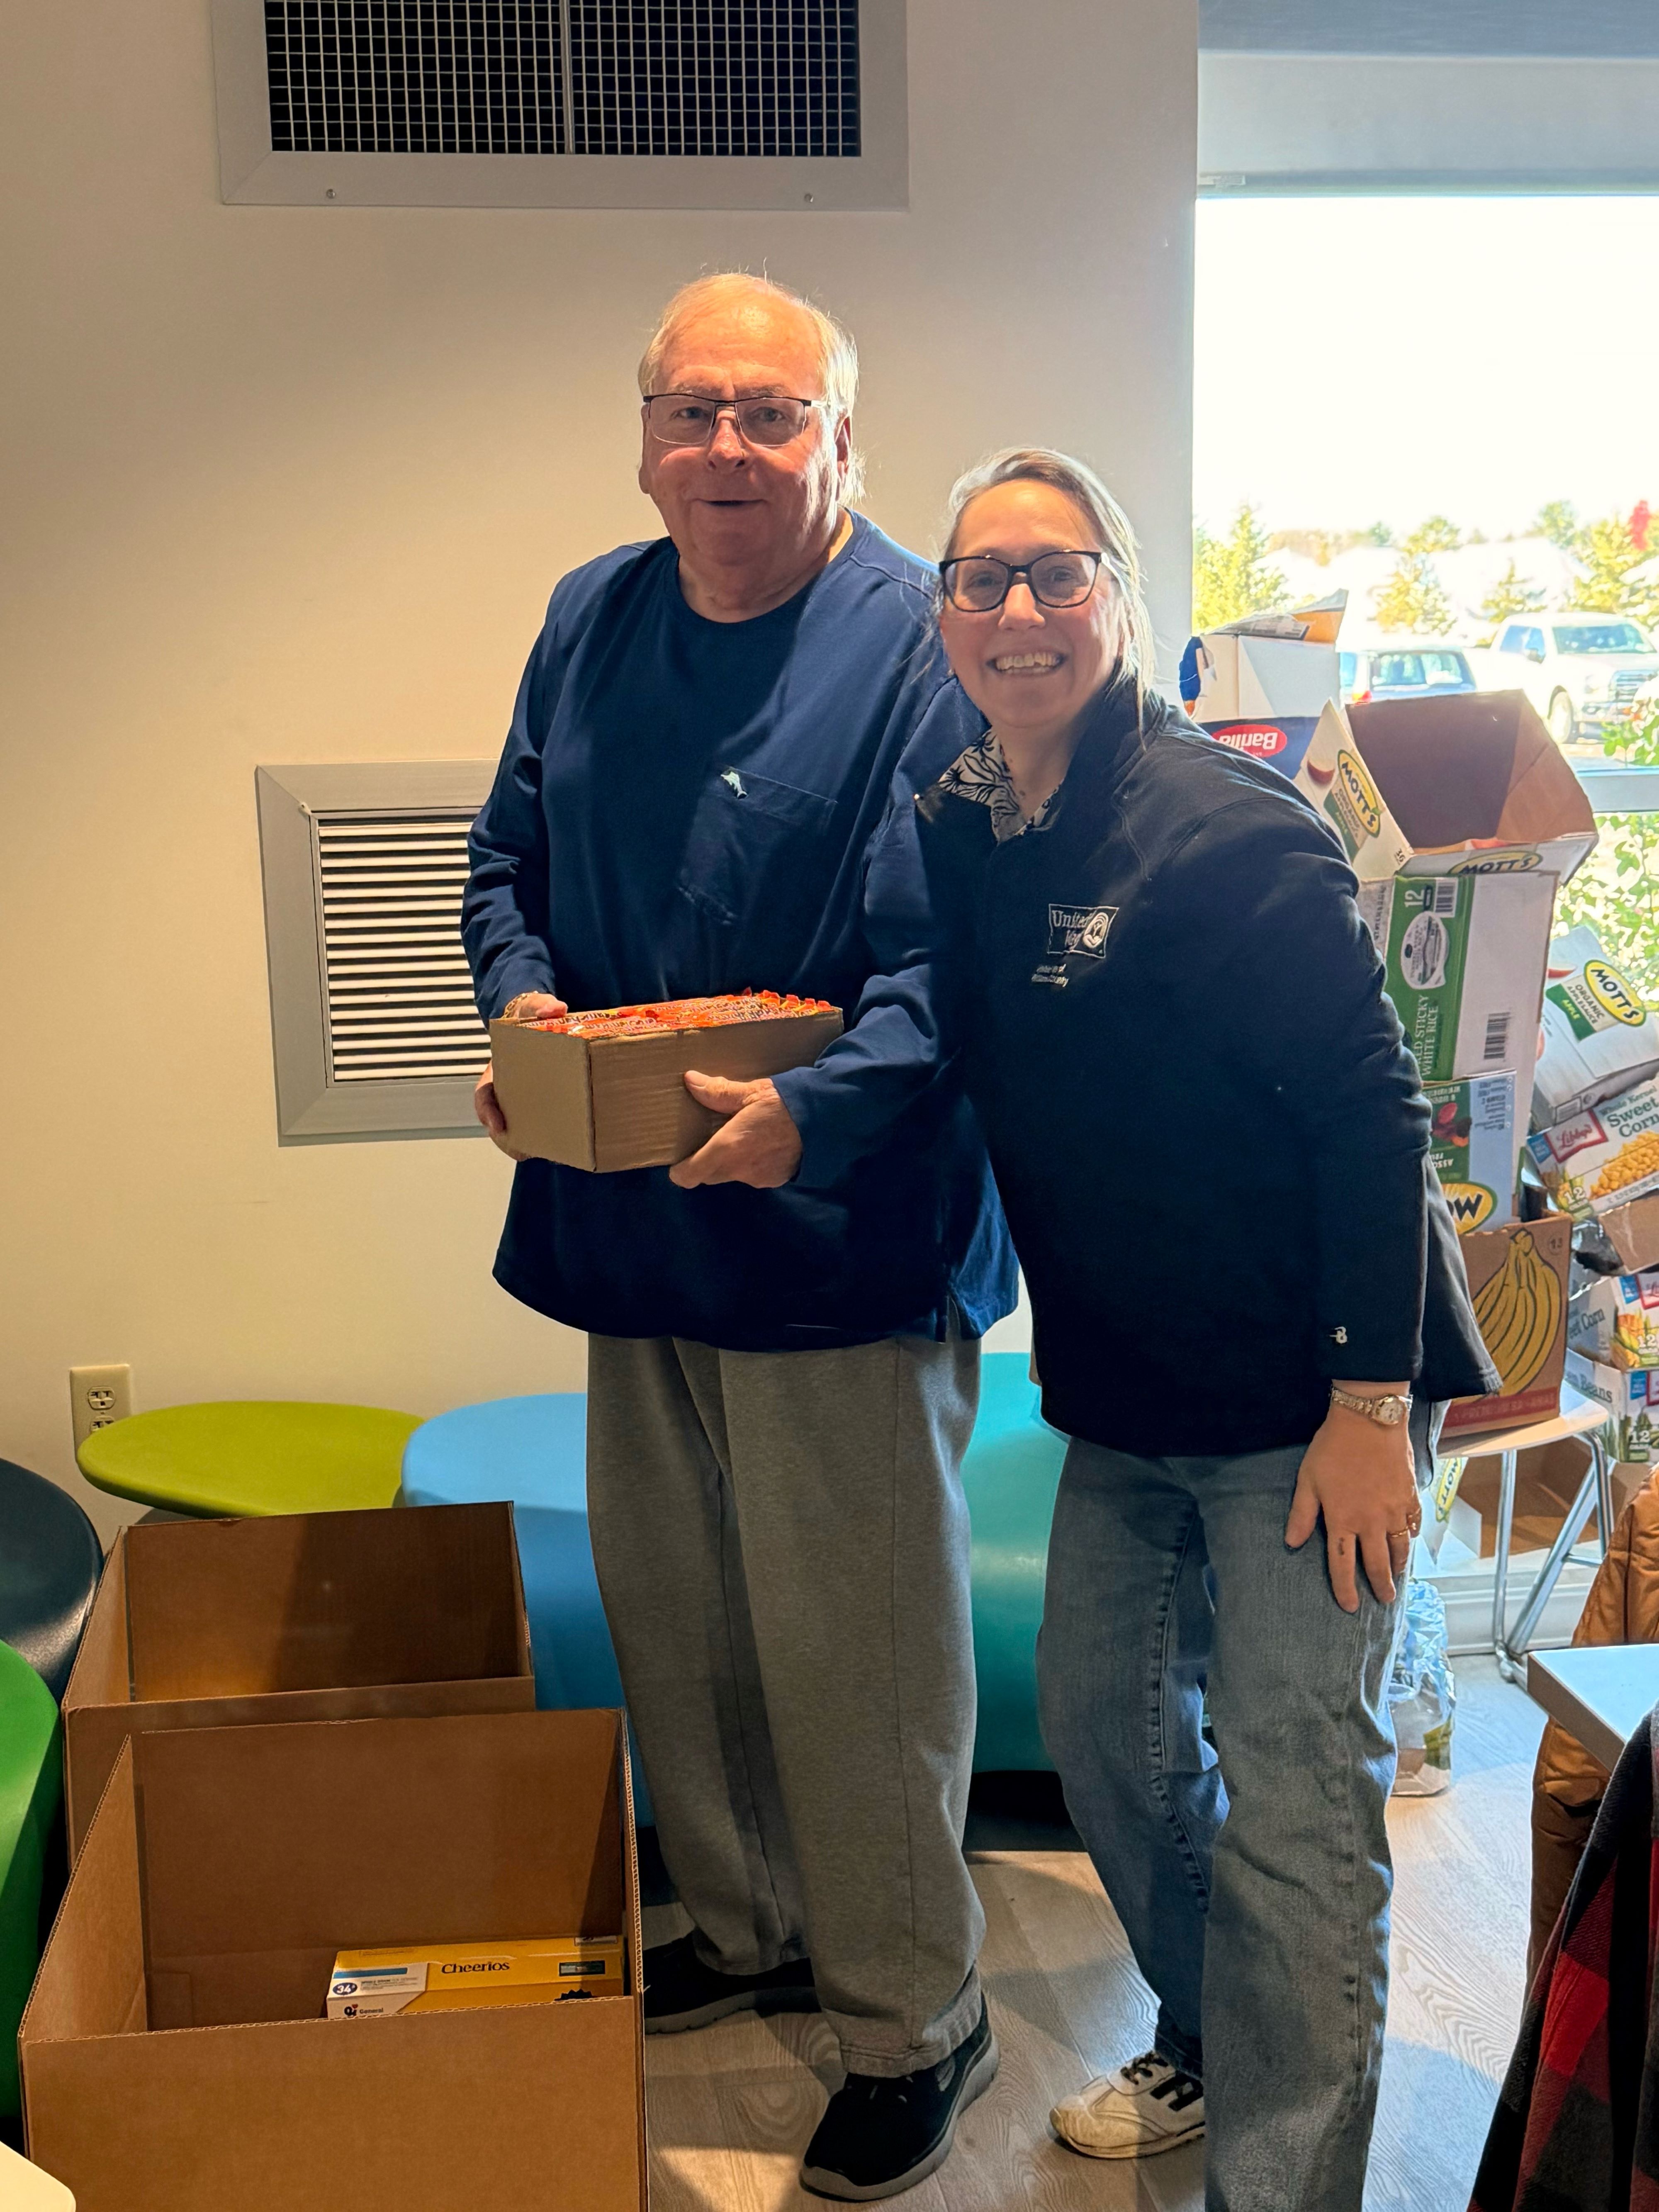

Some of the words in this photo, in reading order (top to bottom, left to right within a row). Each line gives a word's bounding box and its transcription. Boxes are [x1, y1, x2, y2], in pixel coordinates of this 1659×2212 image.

[1218, 732, 1279, 750] Barilla
[1404, 889, 1425, 908] 12
[1562, 999, 1581, 1020] APPLE
[1567, 986, 1598, 1024] APPLESAUCE
[1575, 984, 1605, 1019] ORGANIC
[1415, 995, 1429, 1038] STICKY
[1425, 1005, 1439, 1033] RICE
[1421, 1037, 1435, 1076] WHITE
[1627, 1085, 1658, 1103] Kernel
[1606, 1096, 1659, 1128] Sweet
[1619, 1113, 1659, 1137] Corn
[1564, 1187, 1586, 1205] 12
[1581, 1309, 1605, 1329] Corn
[1637, 1334, 1656, 1348] 12
[1580, 1373, 1612, 1404] Beans
[1630, 1430, 1651, 1443] 12
[441, 1961, 510, 1974] Cheerios
